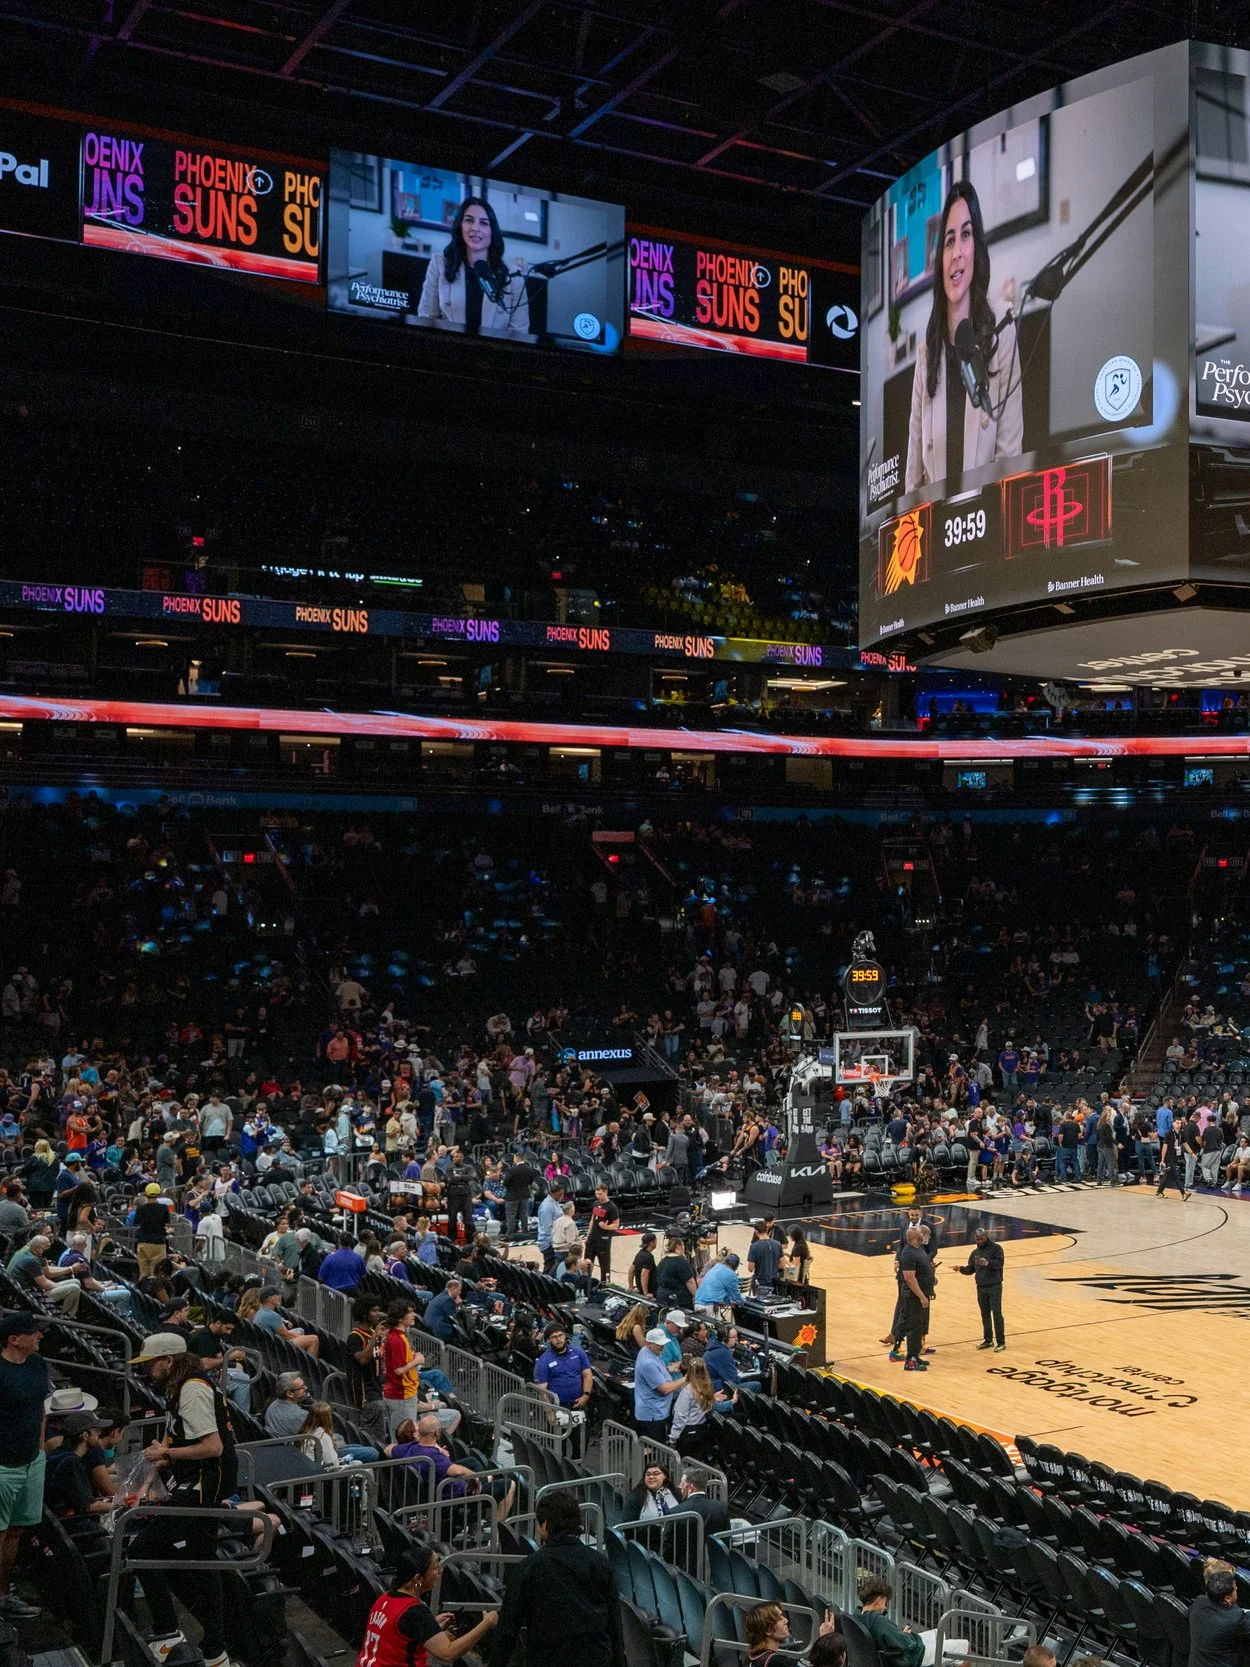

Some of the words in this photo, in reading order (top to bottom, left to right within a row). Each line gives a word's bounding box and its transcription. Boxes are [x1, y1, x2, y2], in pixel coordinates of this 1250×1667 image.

[174, 150, 258, 196] PHOENIX
[173, 183, 258, 246] SUNS
[696, 251, 759, 288] PHOENIX
[779, 266, 808, 298] PHO
[351, 282, 408, 300] Performance
[696, 279, 760, 332] SUNS
[944, 510, 986, 548] 39:59
[1055, 578, 1080, 592] Banner
[1080, 573, 1104, 588] Health
[22, 585, 62, 604] PHOENIX
[64, 586, 105, 614] SUNS
[163, 596, 201, 614] PHOENIX
[202, 599, 240, 624] SUNS
[950, 602, 968, 613] Banner
[968, 596, 985, 609] Health
[296, 606, 331, 624] PHOENIX
[332, 609, 368, 634] SUNS
[431, 617, 466, 634] PHOENIX
[466, 619, 500, 642] SUNS
[546, 626, 578, 642] PHOENIX
[579, 626, 610, 651] SUNS
[654, 634, 684, 651] PHOENIX
[685, 635, 714, 659] SUNS
[766, 644, 794, 660] PHOENIX
[795, 644, 822, 666] SUNS
[860, 650, 887, 666] PHOENIX
[852, 970, 879, 982] 39:59
[578, 1047, 632, 1062] annexus
[803, 1108, 812, 1116] GET
[756, 1170, 782, 1184] coinbase
[1034, 1359, 1160, 1396] matchup
[1112, 1366, 1185, 1386] center
[986, 1366, 1157, 1417] mortgage
